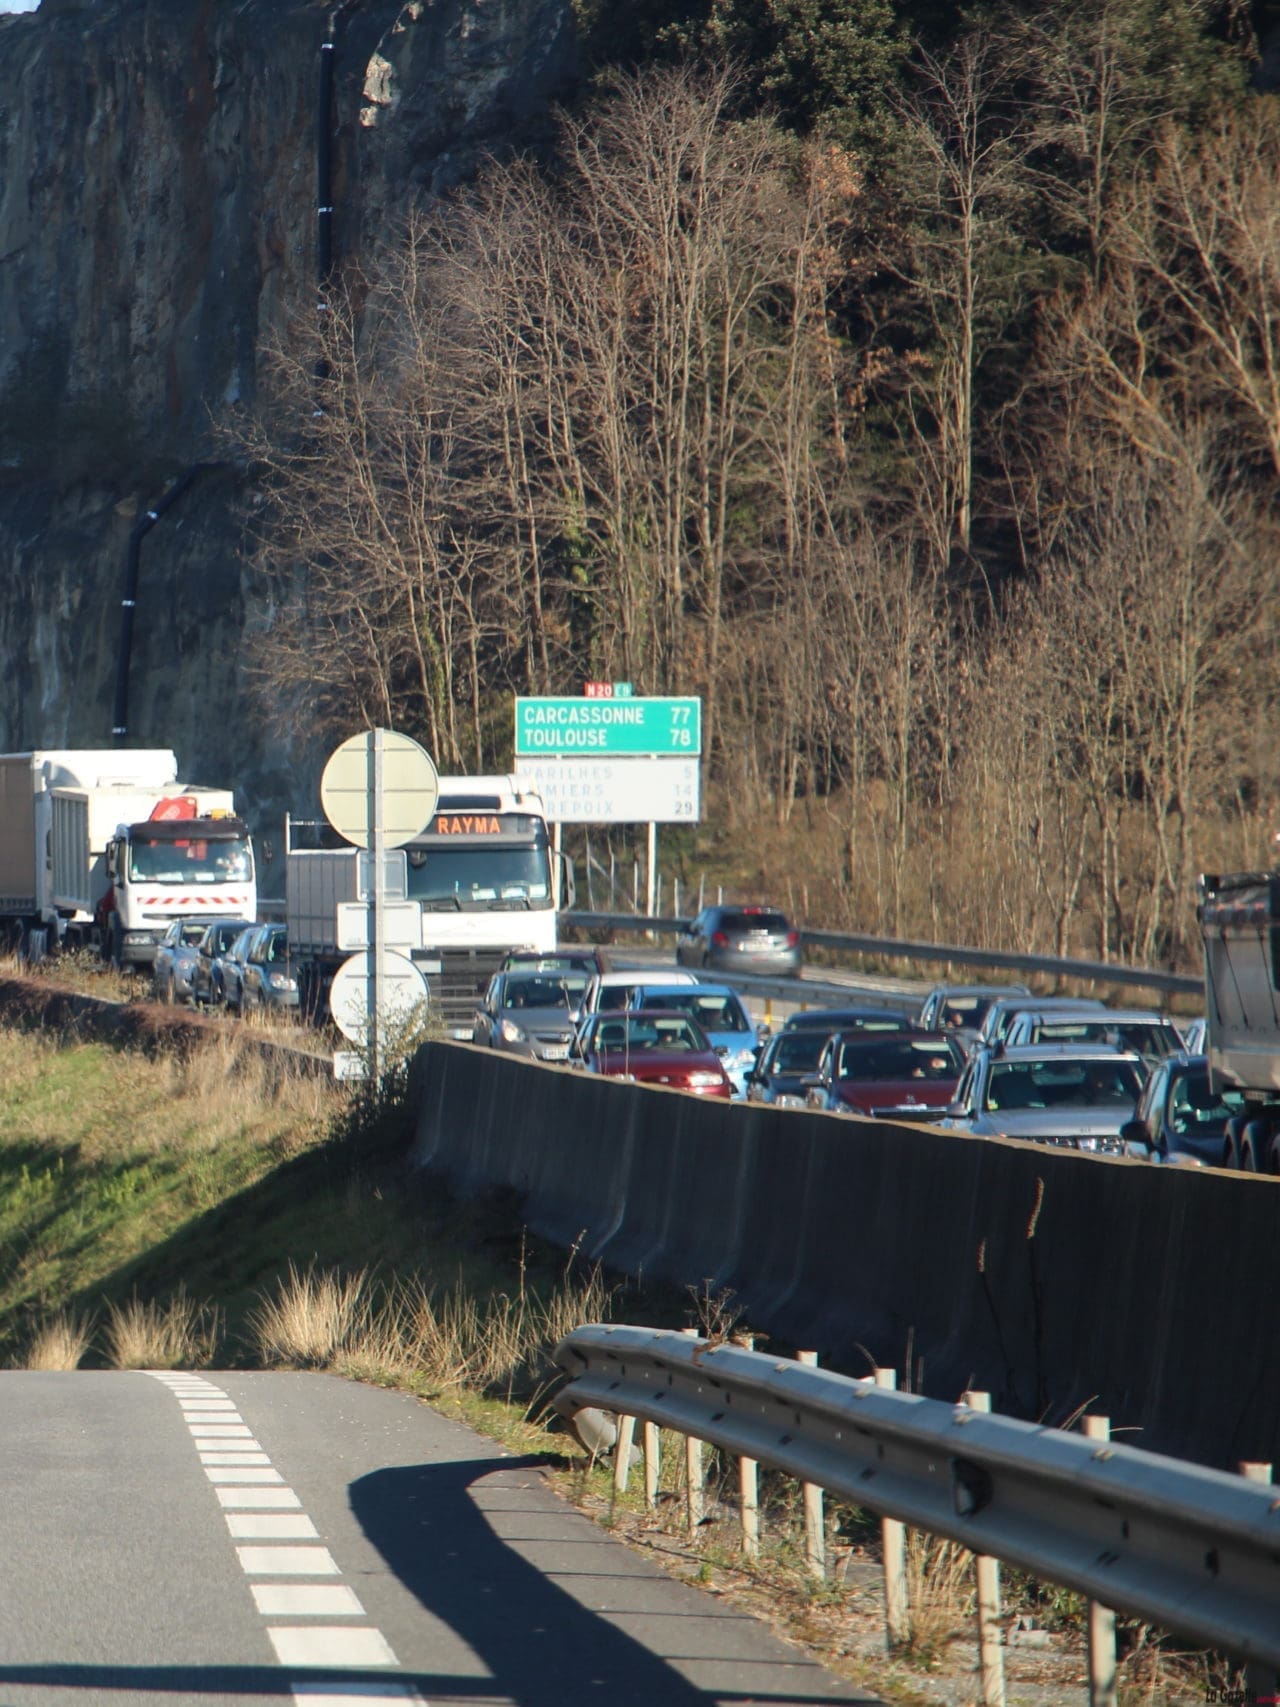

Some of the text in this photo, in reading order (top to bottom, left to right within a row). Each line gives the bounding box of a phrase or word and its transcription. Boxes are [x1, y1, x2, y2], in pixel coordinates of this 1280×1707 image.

[524, 706, 691, 725] CARCASSONNE 77
[524, 728, 691, 747] TOULOUSE 78
[541, 783, 692, 797] MIERS 14
[547, 800, 693, 815] REPOIX 29
[437, 815, 501, 834] RAYMA
